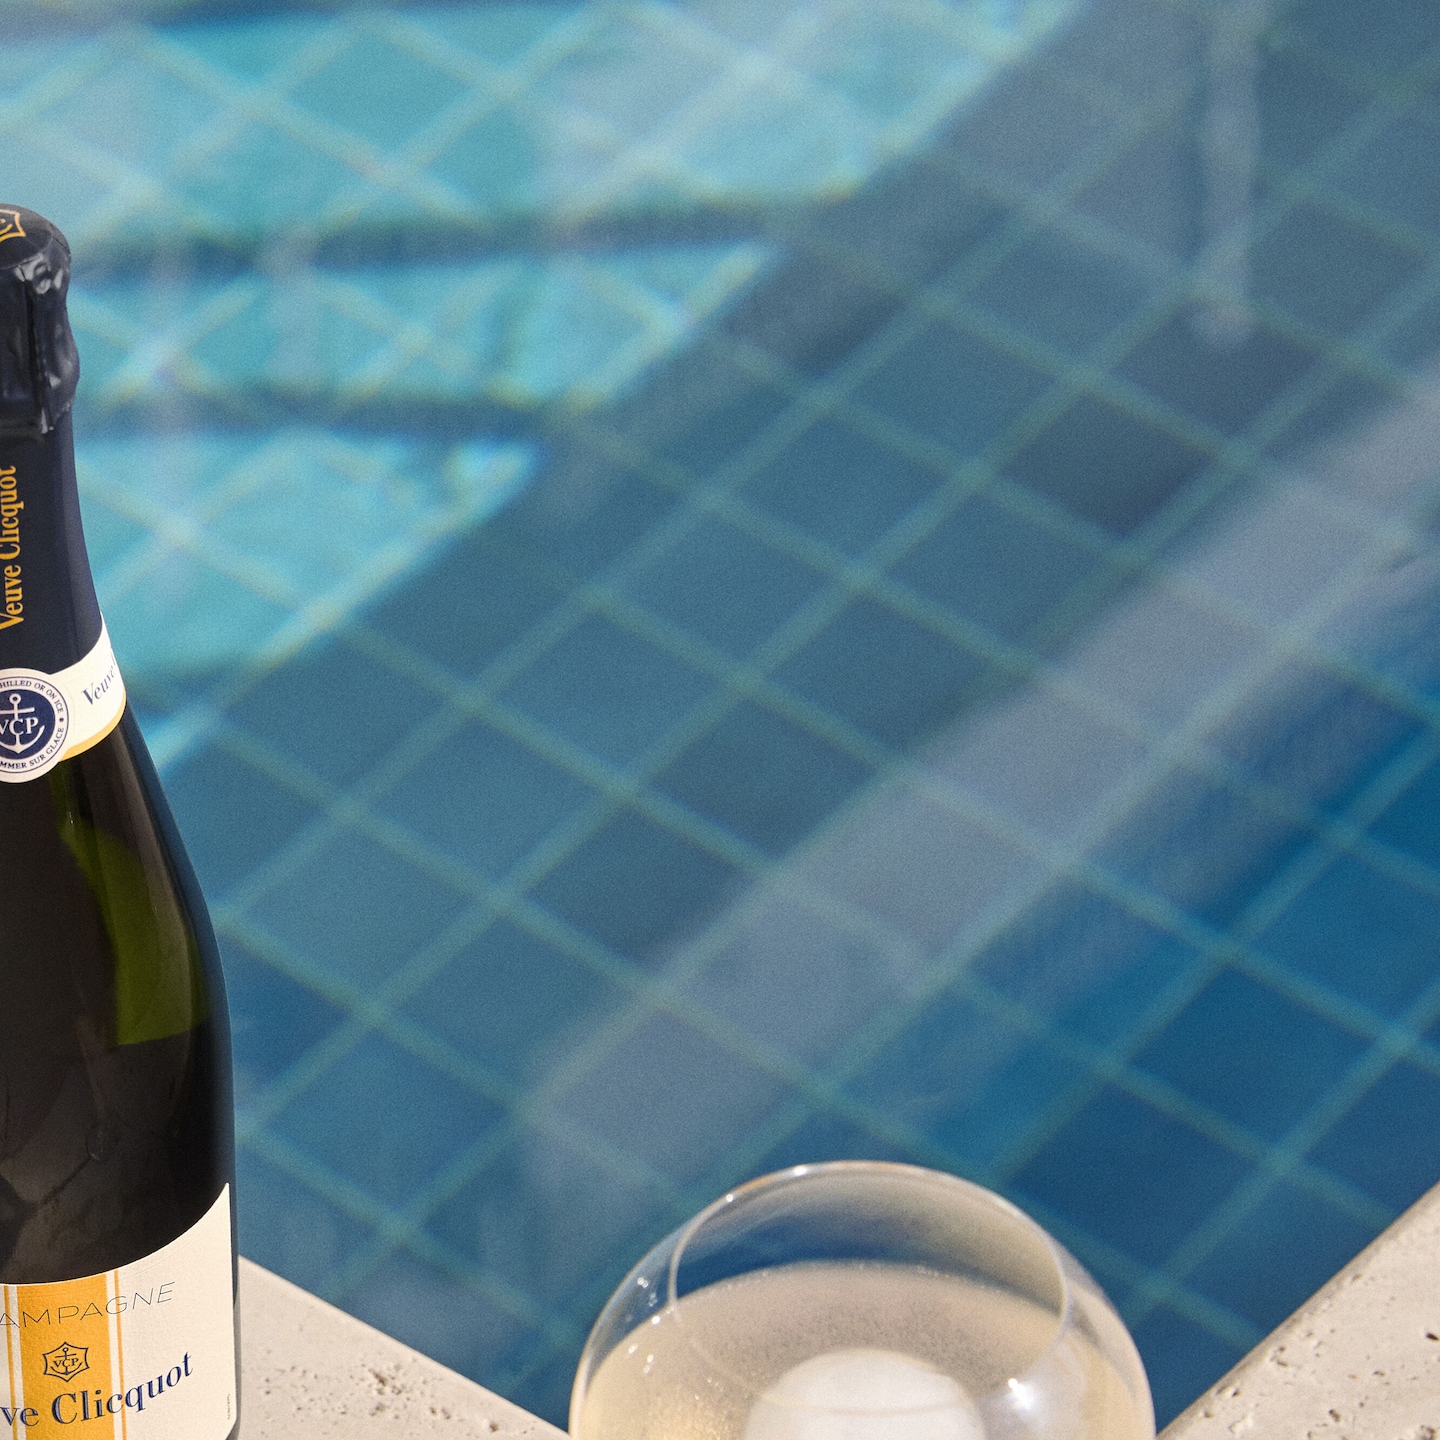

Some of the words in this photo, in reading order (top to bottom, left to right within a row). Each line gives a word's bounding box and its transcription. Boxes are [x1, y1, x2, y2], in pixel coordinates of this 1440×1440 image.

[34, 683, 46, 691] OR
[46, 689, 57, 699] ON
[55, 699, 64, 713] ICE
[29, 754, 46, 765] SUR
[46, 727, 64, 755] GLACE
[53, 1357, 79, 1367] VCP
[51, 1351, 193, 1425] Clicquot
